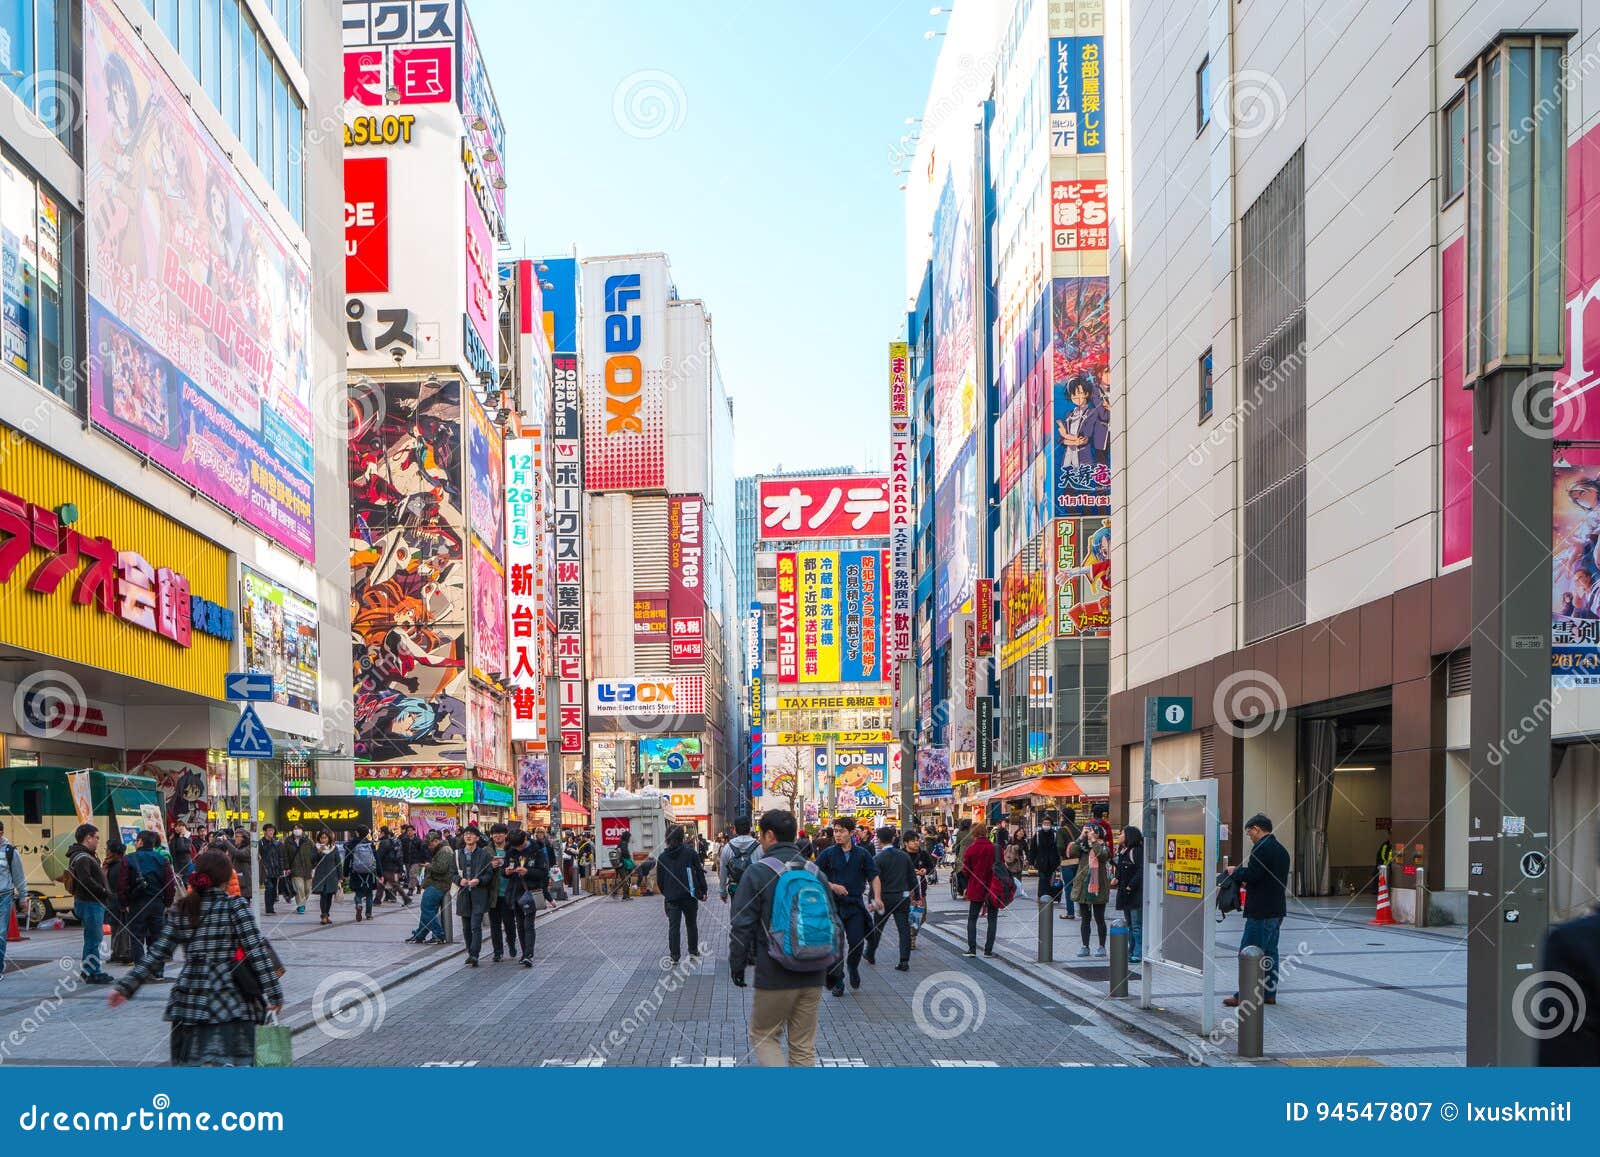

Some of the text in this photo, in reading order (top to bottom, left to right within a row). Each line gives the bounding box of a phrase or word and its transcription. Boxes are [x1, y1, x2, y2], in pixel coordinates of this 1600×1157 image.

[1057, 40, 1071, 111] レオパレス21
[1081, 43, 1100, 148] お部屋探しは
[1052, 131, 1075, 148] 7F
[1053, 201, 1106, 227] ぽち
[1057, 230, 1075, 247] 6F
[554, 357, 567, 437] PARADISE
[567, 357, 577, 411] HOBBY
[893, 357, 906, 412] まんが喫茶
[893, 442, 909, 525] TAKARADA
[671, 500, 681, 569] Flagship Store
[680, 501, 702, 588] Duty Free
[556, 465, 583, 753] ボークス秋葉原ホビー天国
[779, 594, 797, 630] TAX
[803, 557, 818, 676] 都内・近郊送料無料
[820, 557, 834, 646] 冷蔵庫洗濯機
[846, 565, 859, 661] お見積り無料です
[894, 569, 909, 609] 免税商店
[511, 562, 535, 721] 新台入替
[751, 608, 762, 669] Panasonic
[779, 632, 797, 678] FREE
[657, 703, 678, 711] Store
[752, 678, 761, 727] ONODEN
[784, 698, 808, 708] TAX
[811, 698, 844, 707] FREE
[846, 697, 875, 707] 免税店
[784, 734, 810, 743] テレビ
[844, 733, 879, 742] エアコン
